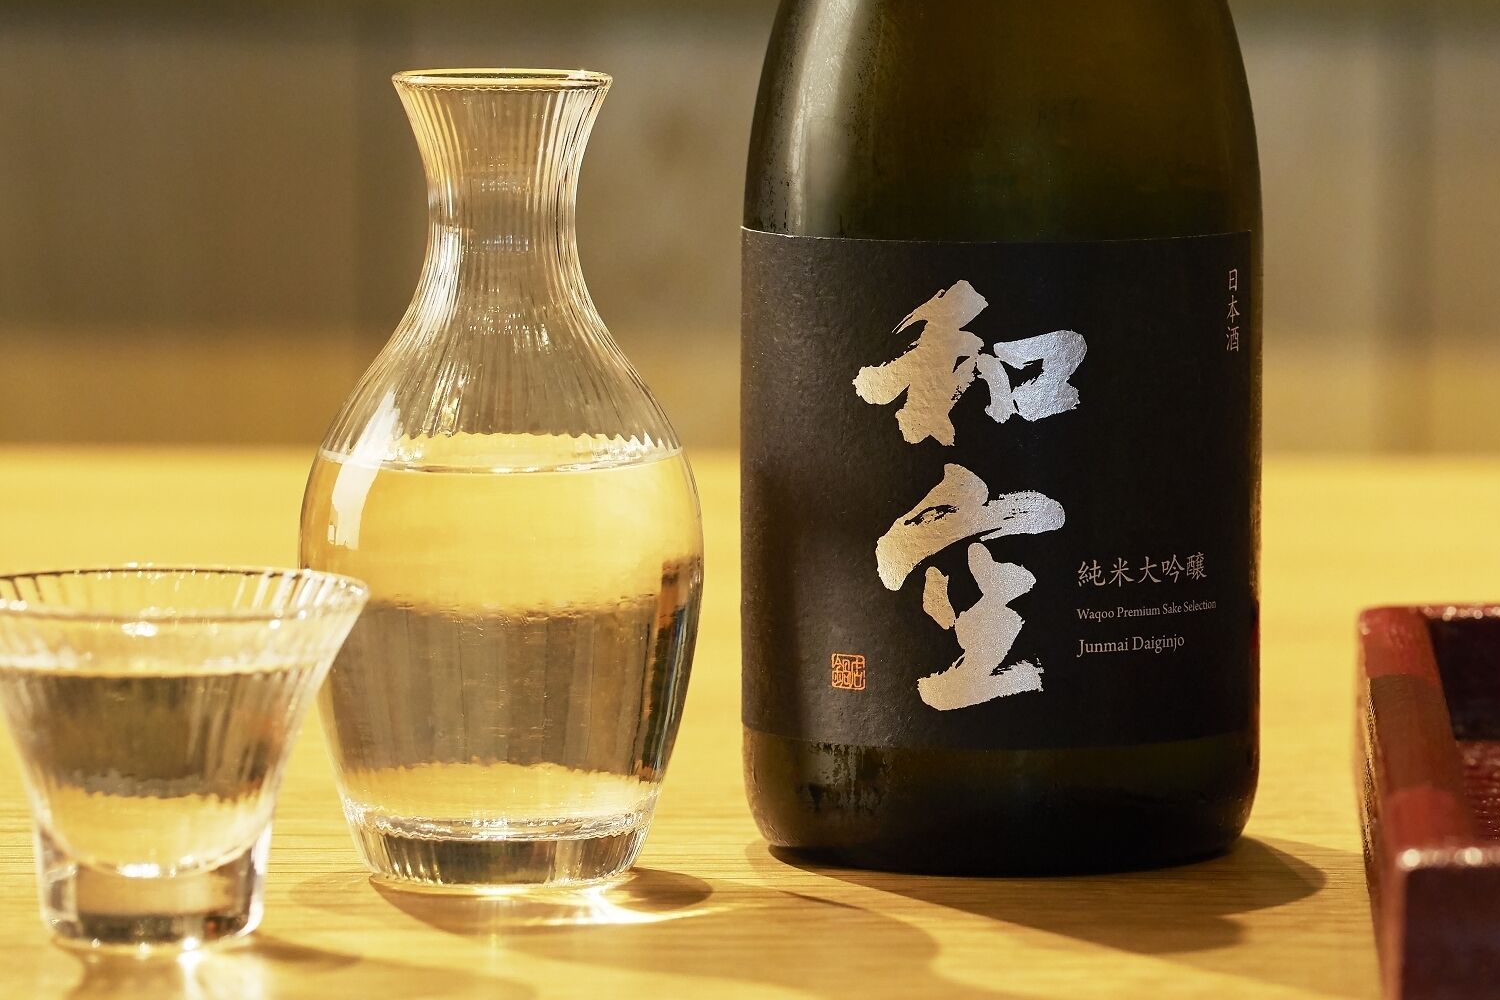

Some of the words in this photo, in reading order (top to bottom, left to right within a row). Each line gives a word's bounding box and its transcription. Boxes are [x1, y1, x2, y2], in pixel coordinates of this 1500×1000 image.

[1225, 268, 1241, 352] 日本酒
[852, 279, 1088, 712] 和空
[1076, 551, 1208, 588] 純米大吟醸
[1077, 608, 1115, 622] Waqoo
[1117, 605, 1161, 618] Premium
[1162, 602, 1182, 616] Sake
[1183, 599, 1217, 613] Selection
[1076, 637, 1129, 658] Junmai
[1131, 633, 1185, 654] Daiginjo
